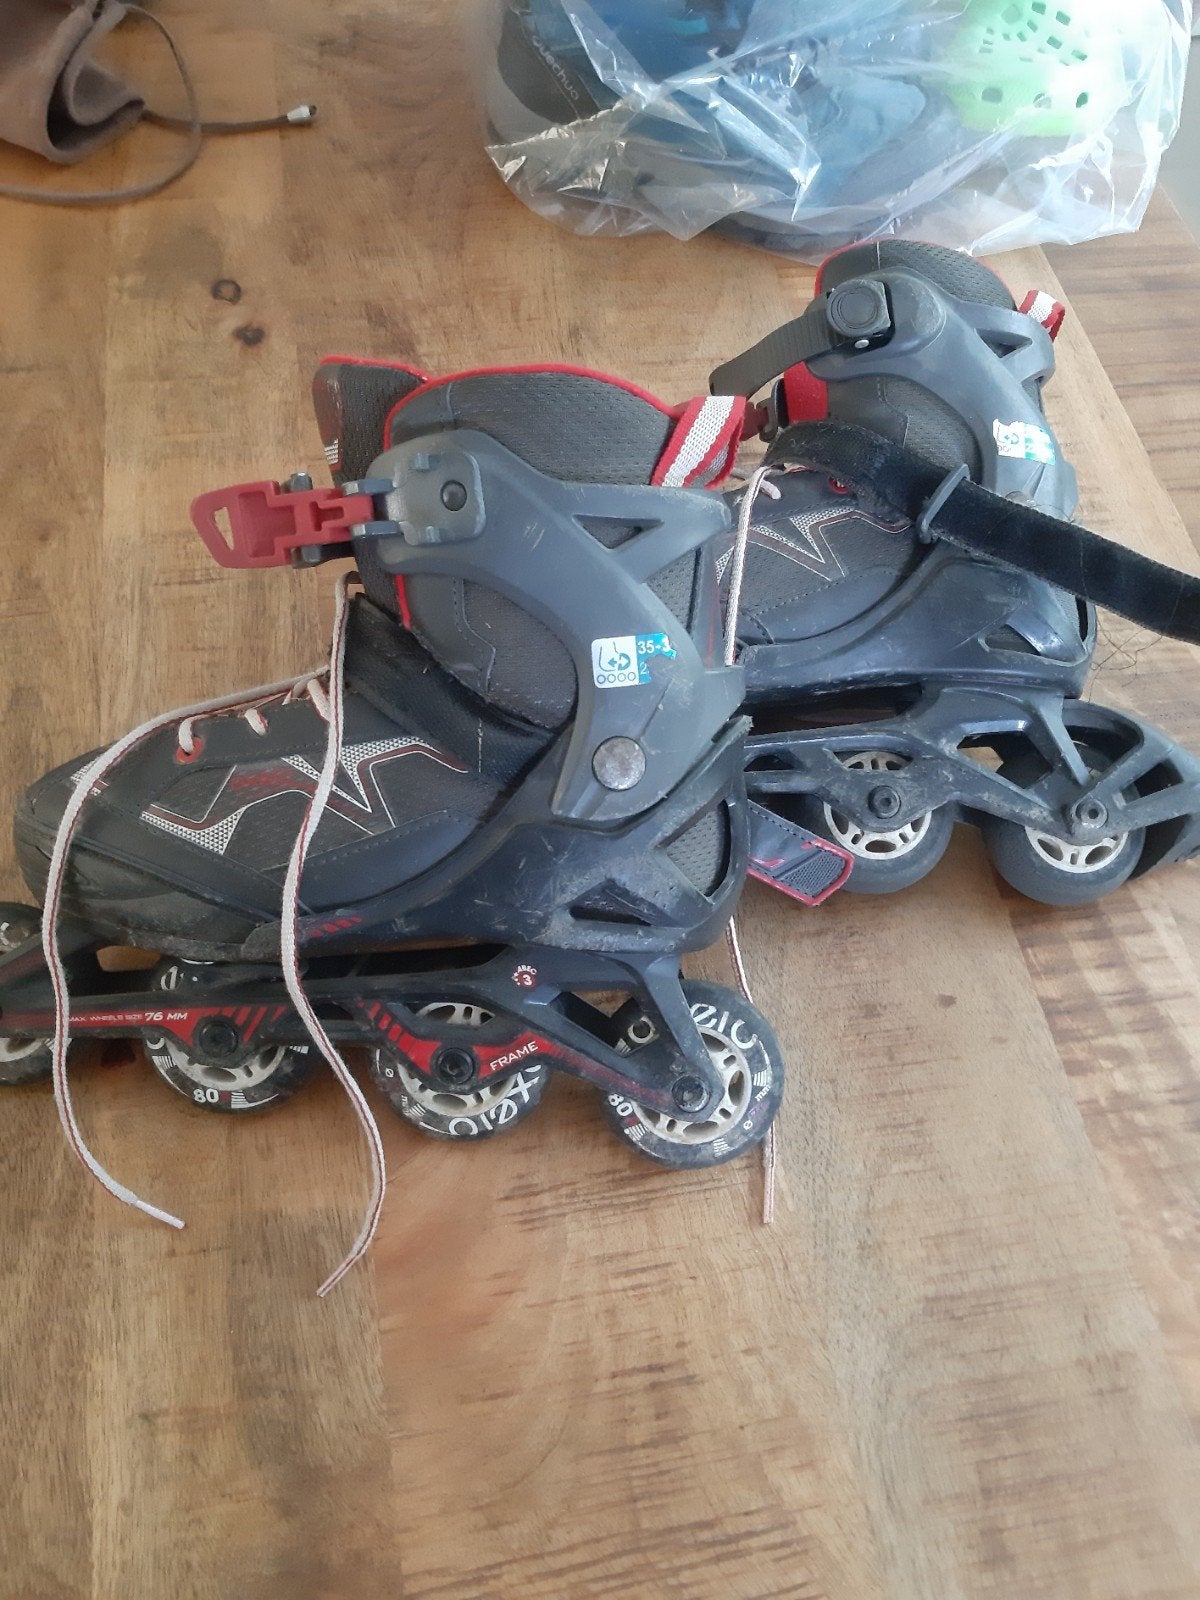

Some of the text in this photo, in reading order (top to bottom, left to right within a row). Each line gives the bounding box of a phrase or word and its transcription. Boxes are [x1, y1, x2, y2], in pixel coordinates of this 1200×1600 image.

[531, 35, 579, 101] quechua
[522, 974, 533, 986] 3
[144, 1011, 163, 1022] 76
[166, 1012, 188, 1021] MM
[490, 1041, 539, 1071] FRAME
[193, 1088, 220, 1104] 80
[608, 1093, 634, 1117] 80
